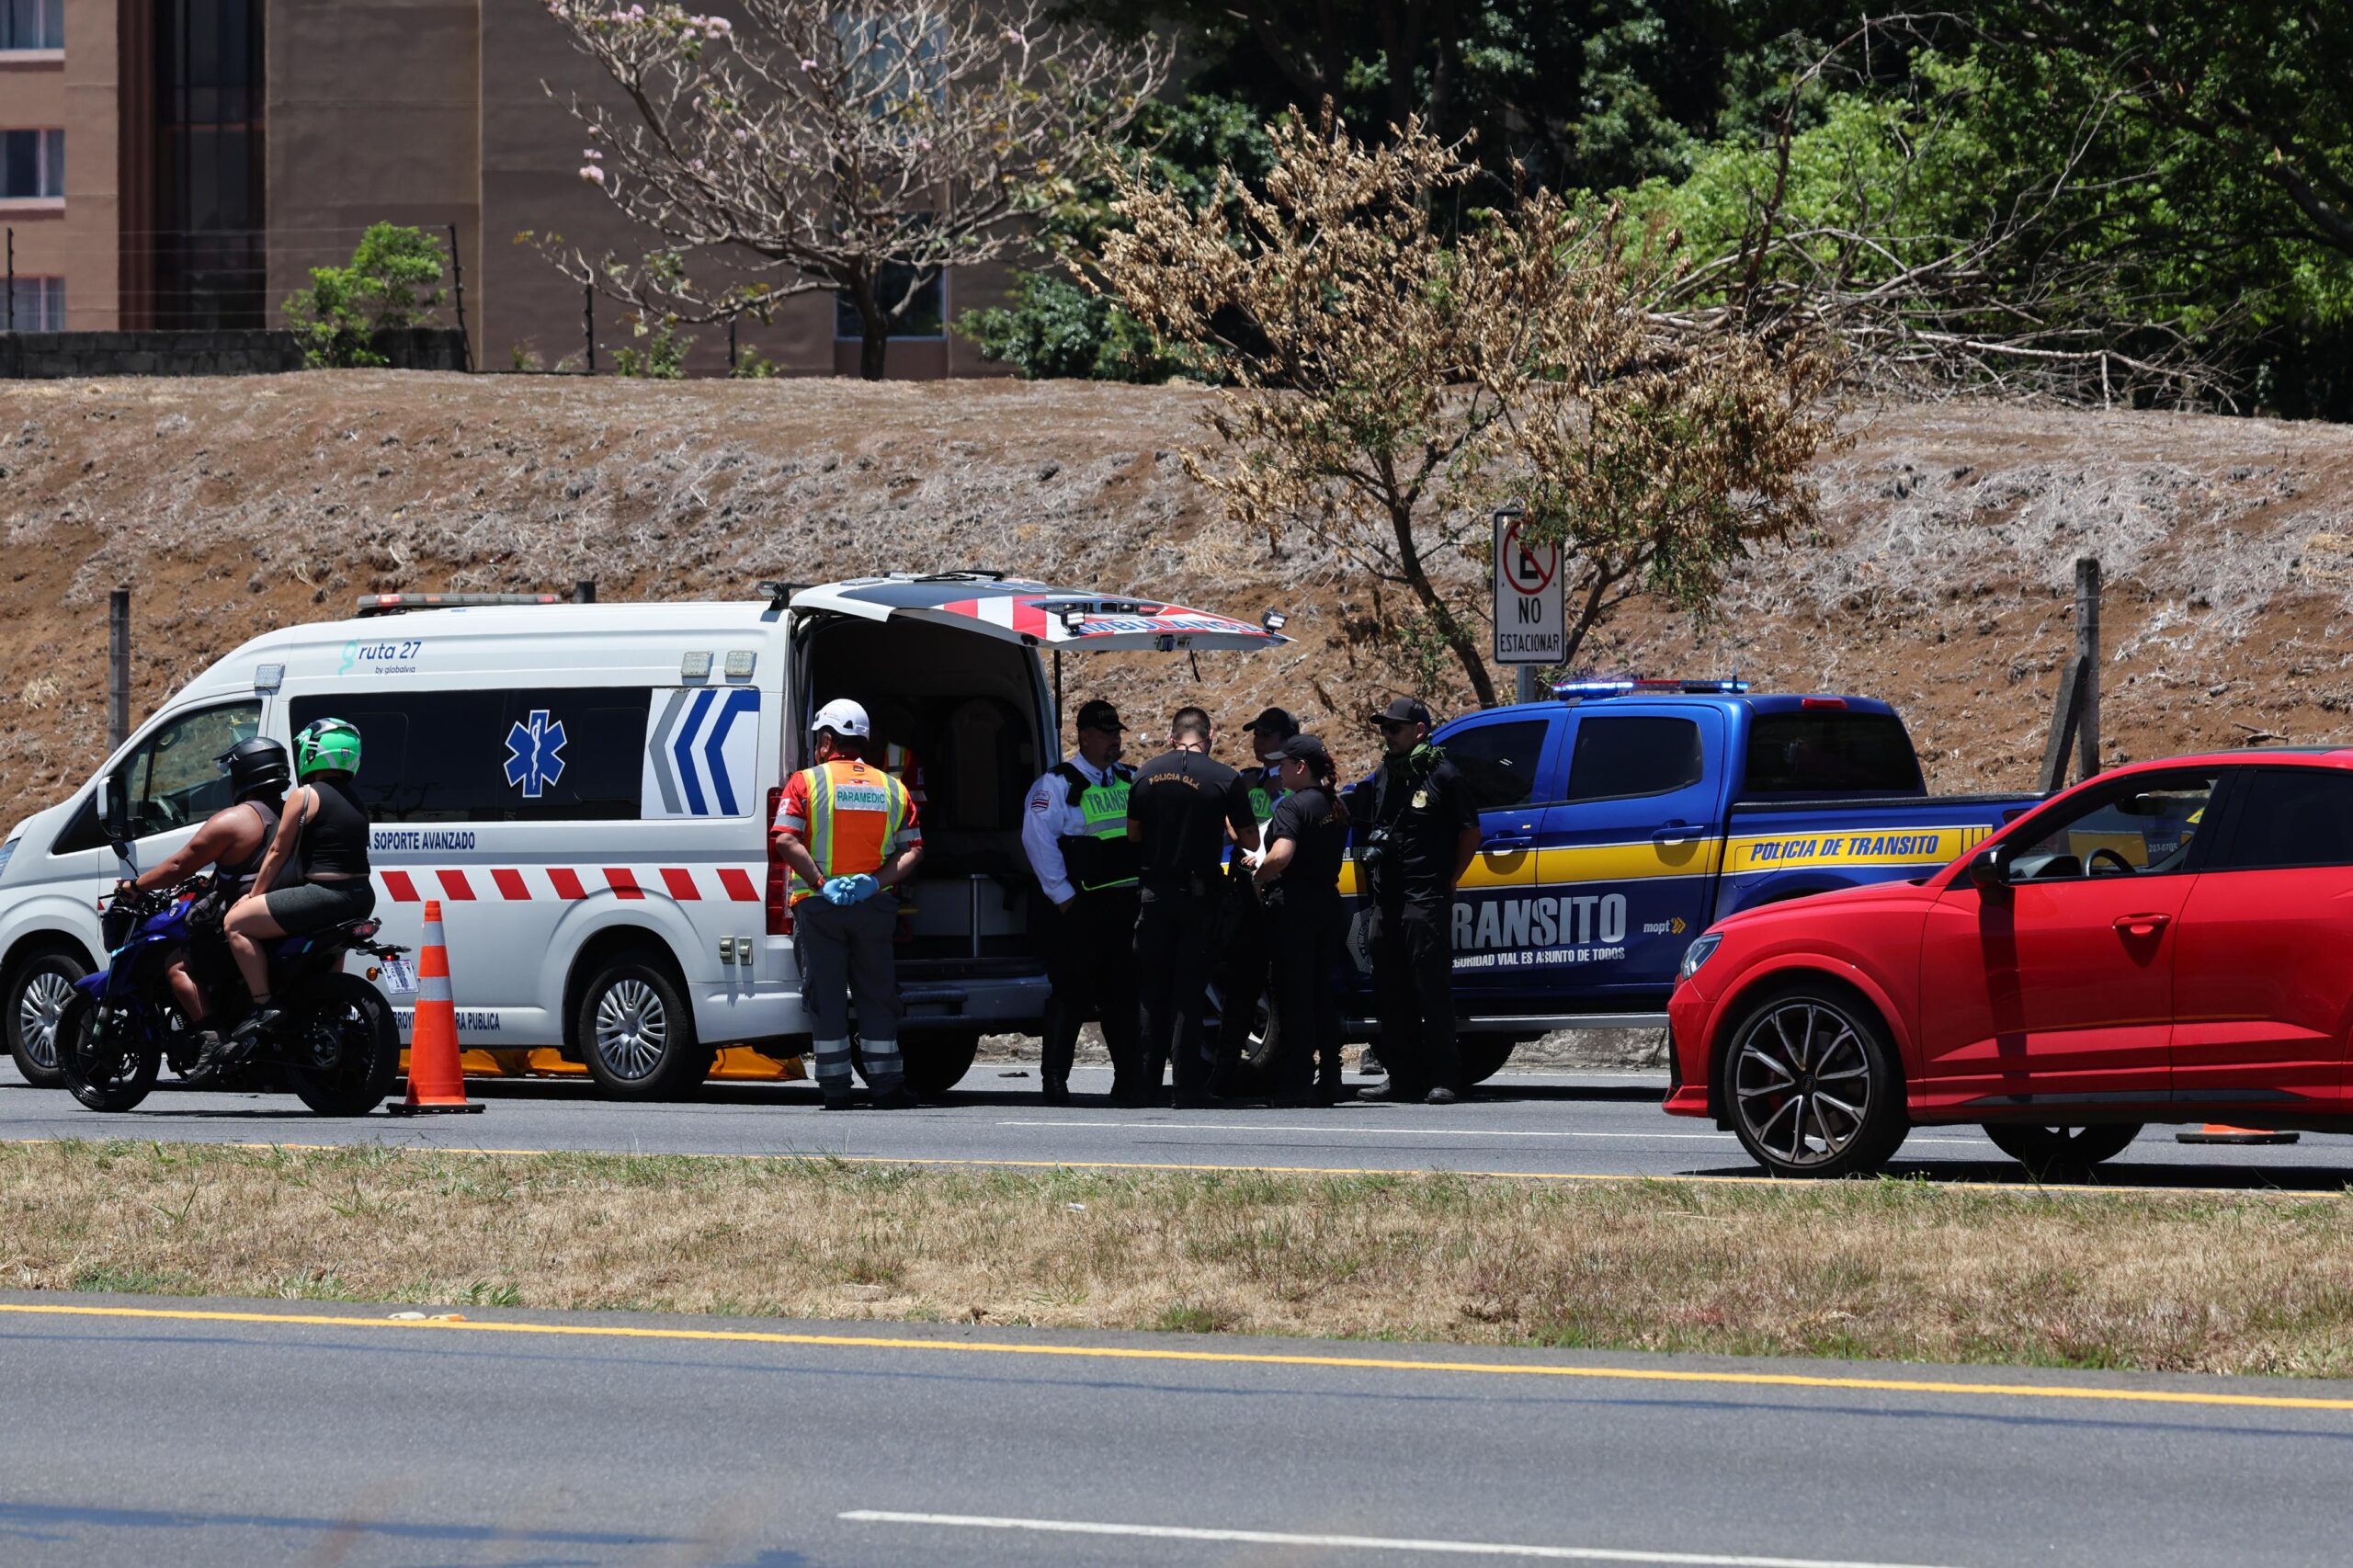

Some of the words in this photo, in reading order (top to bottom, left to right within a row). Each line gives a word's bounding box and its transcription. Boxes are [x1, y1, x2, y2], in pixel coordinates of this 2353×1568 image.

[1518, 598, 1541, 624] NO
[358, 642, 396, 660] ruta
[399, 642, 422, 659] 27
[1500, 633, 1559, 653] ESTACIONAR
[375, 665, 383, 675] by
[384, 665, 415, 675] globalvia
[1148, 772, 1180, 785] POLICIA
[374, 832, 419, 850] SOPORTE
[423, 831, 475, 850] AVANZADO
[1750, 839, 1817, 862] POLICIA
[1819, 838, 1845, 857] DE
[1847, 835, 1939, 856] TRANSITO
[1643, 920, 1670, 935] mopt
[1497, 951, 1518, 966] VIAL
[1521, 952, 1533, 964] ES
[1536, 949, 1574, 964] ASUNTO
[1577, 949, 1589, 962] DE
[1592, 947, 1625, 960] TODOS
[468, 1012, 500, 1030] PUBLICA
